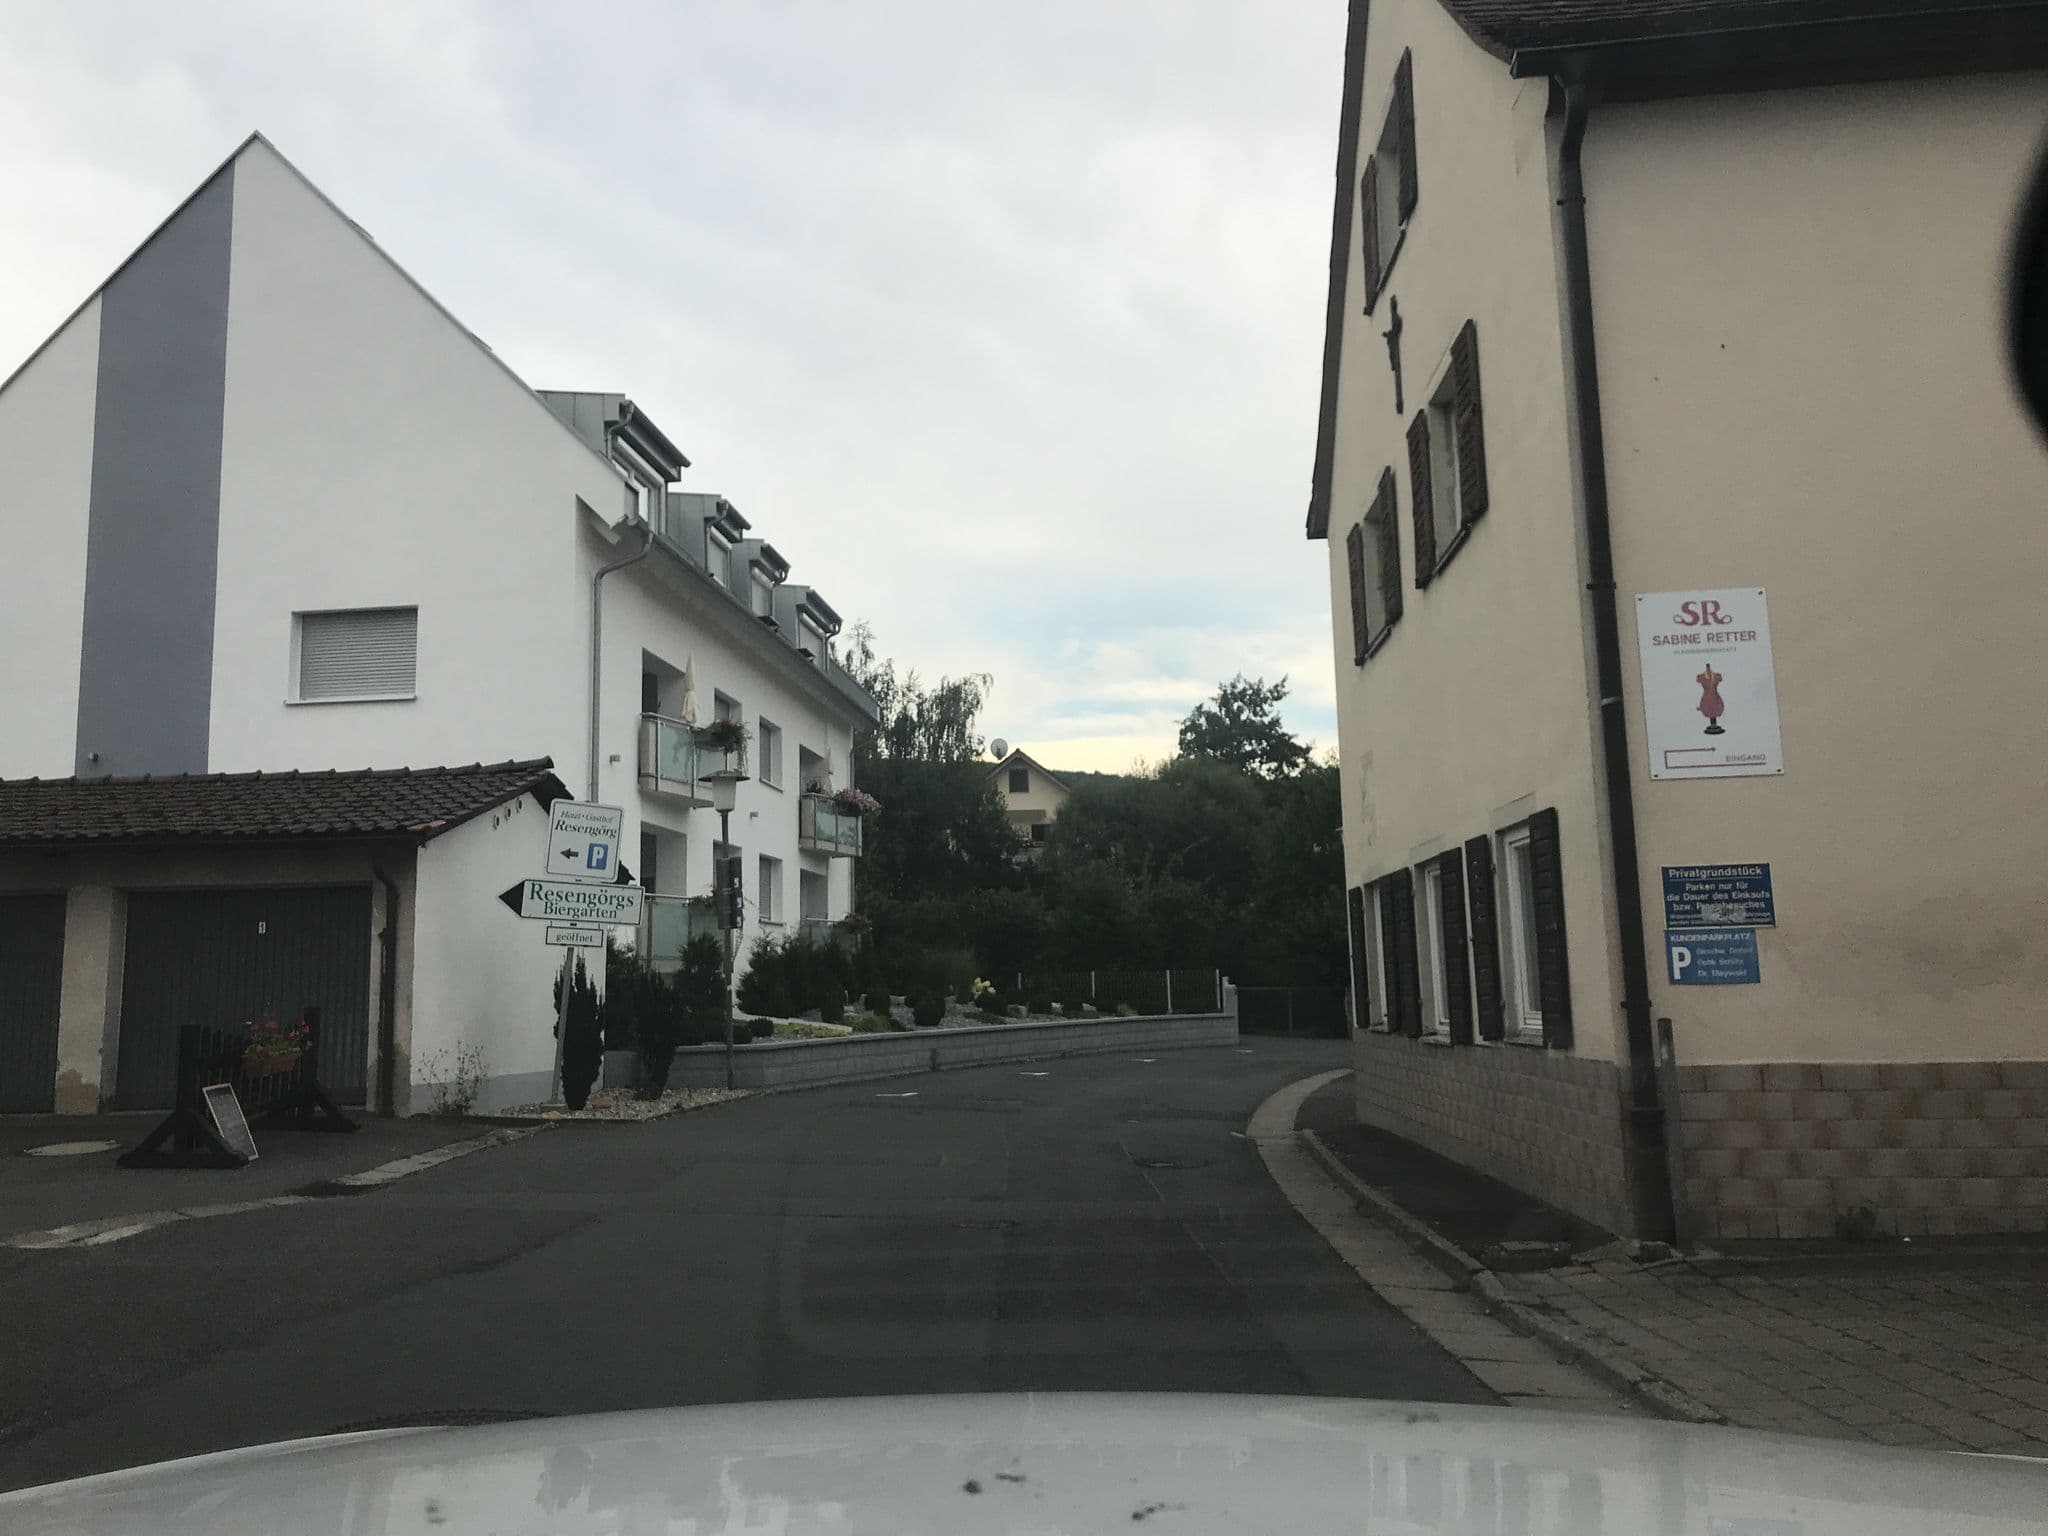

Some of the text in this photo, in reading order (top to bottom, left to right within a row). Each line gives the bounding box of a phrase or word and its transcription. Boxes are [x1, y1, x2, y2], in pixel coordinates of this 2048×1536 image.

[1673, 600, 1732, 626] SR
[1652, 630, 1757, 646] SABINE RETTER
[560, 810, 582, 820] Hotel
[554, 819, 617, 839] Resengörg
[591, 846, 605, 867] P
[1668, 866, 1763, 879] Privatgrundstück
[1685, 882, 1716, 891] Parken
[1736, 881, 1748, 889] für
[529, 882, 635, 910] Resengörgs
[1666, 890, 1770, 902] die Dauer des Einkaufs
[543, 902, 617, 919] Biergarten
[1673, 903, 1694, 911] bzw.
[555, 932, 593, 942] geöffnet
[1672, 946, 1691, 980] P
